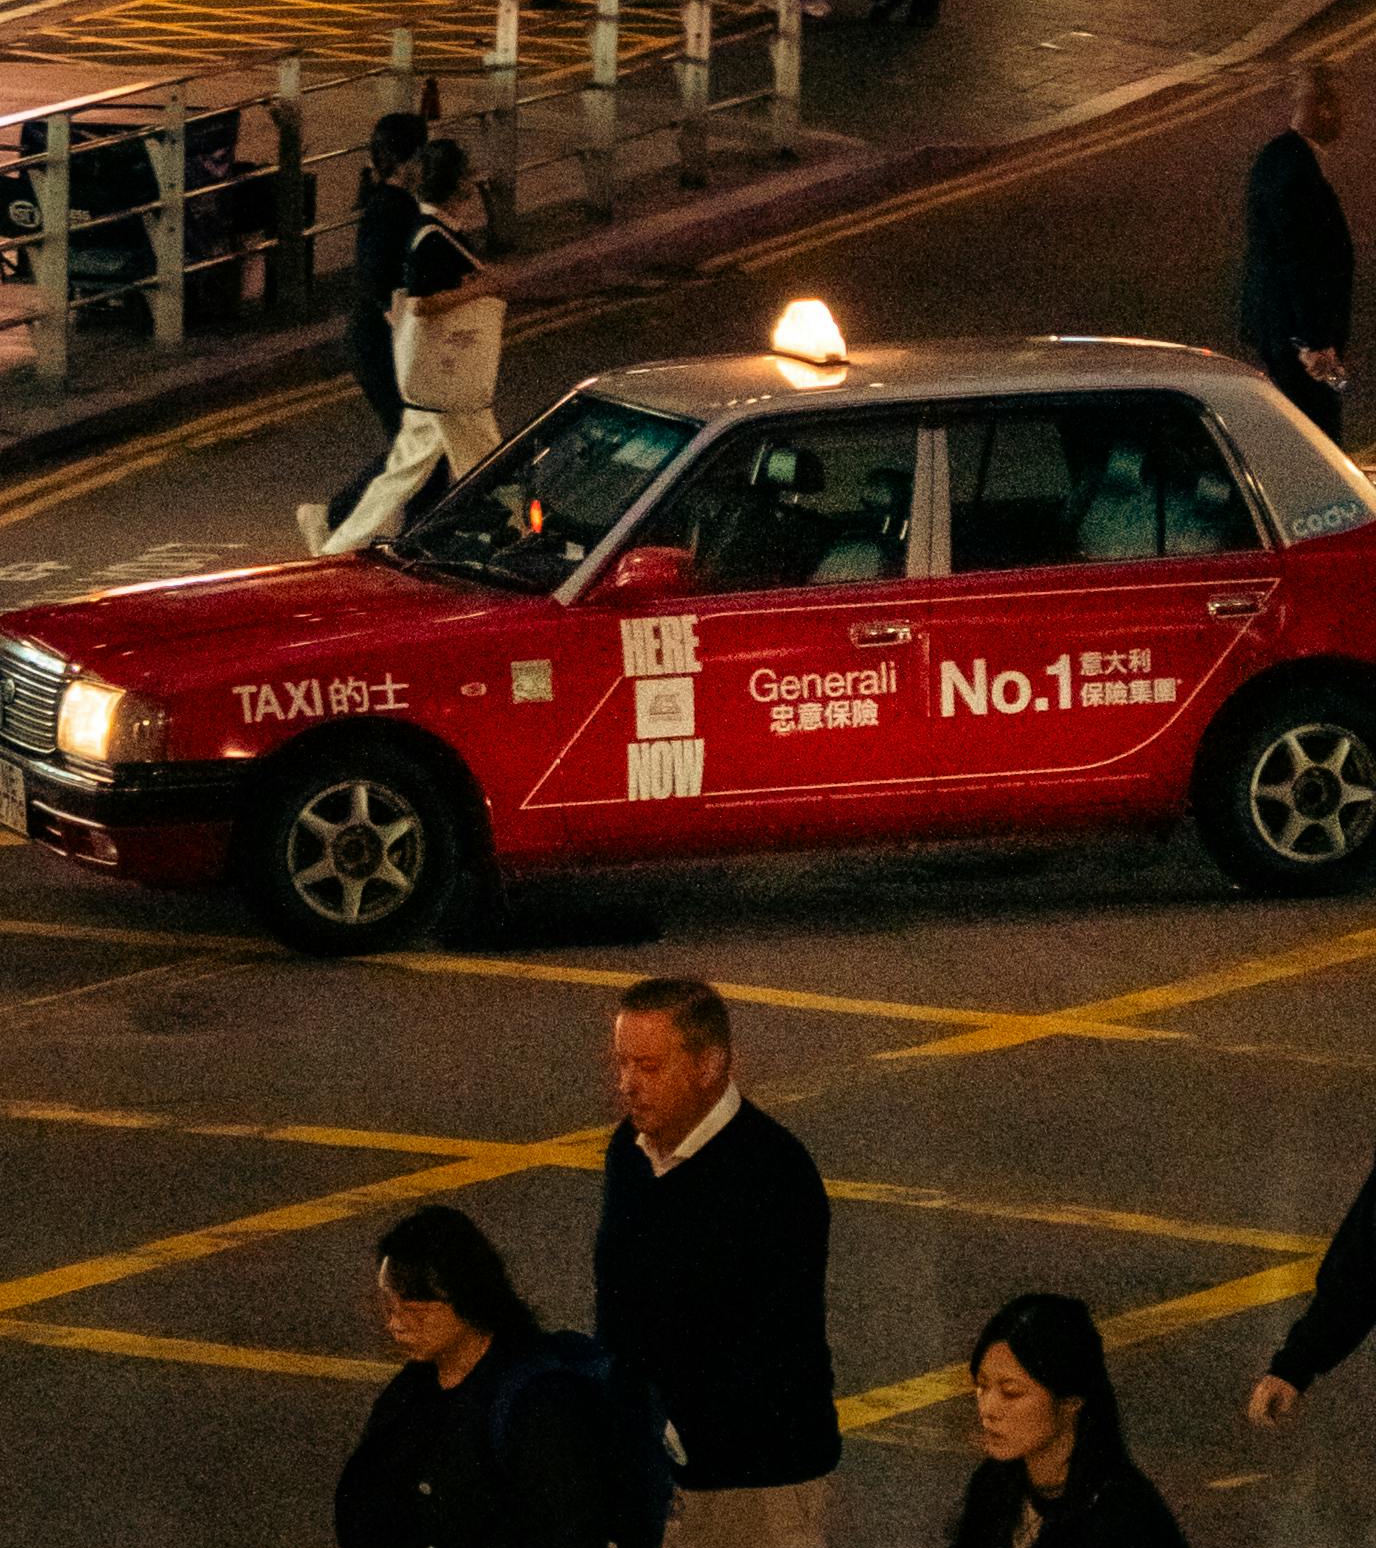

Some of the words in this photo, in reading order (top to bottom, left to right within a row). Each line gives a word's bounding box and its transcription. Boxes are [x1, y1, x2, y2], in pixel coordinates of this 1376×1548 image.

[749, 661, 897, 702] Generali
[1079, 648, 1152, 676] 意大利
[232, 678, 324, 724] TAXI
[329, 673, 409, 715] 的士
[940, 653, 1072, 718] No.1
[770, 698, 879, 738] 忠意保險
